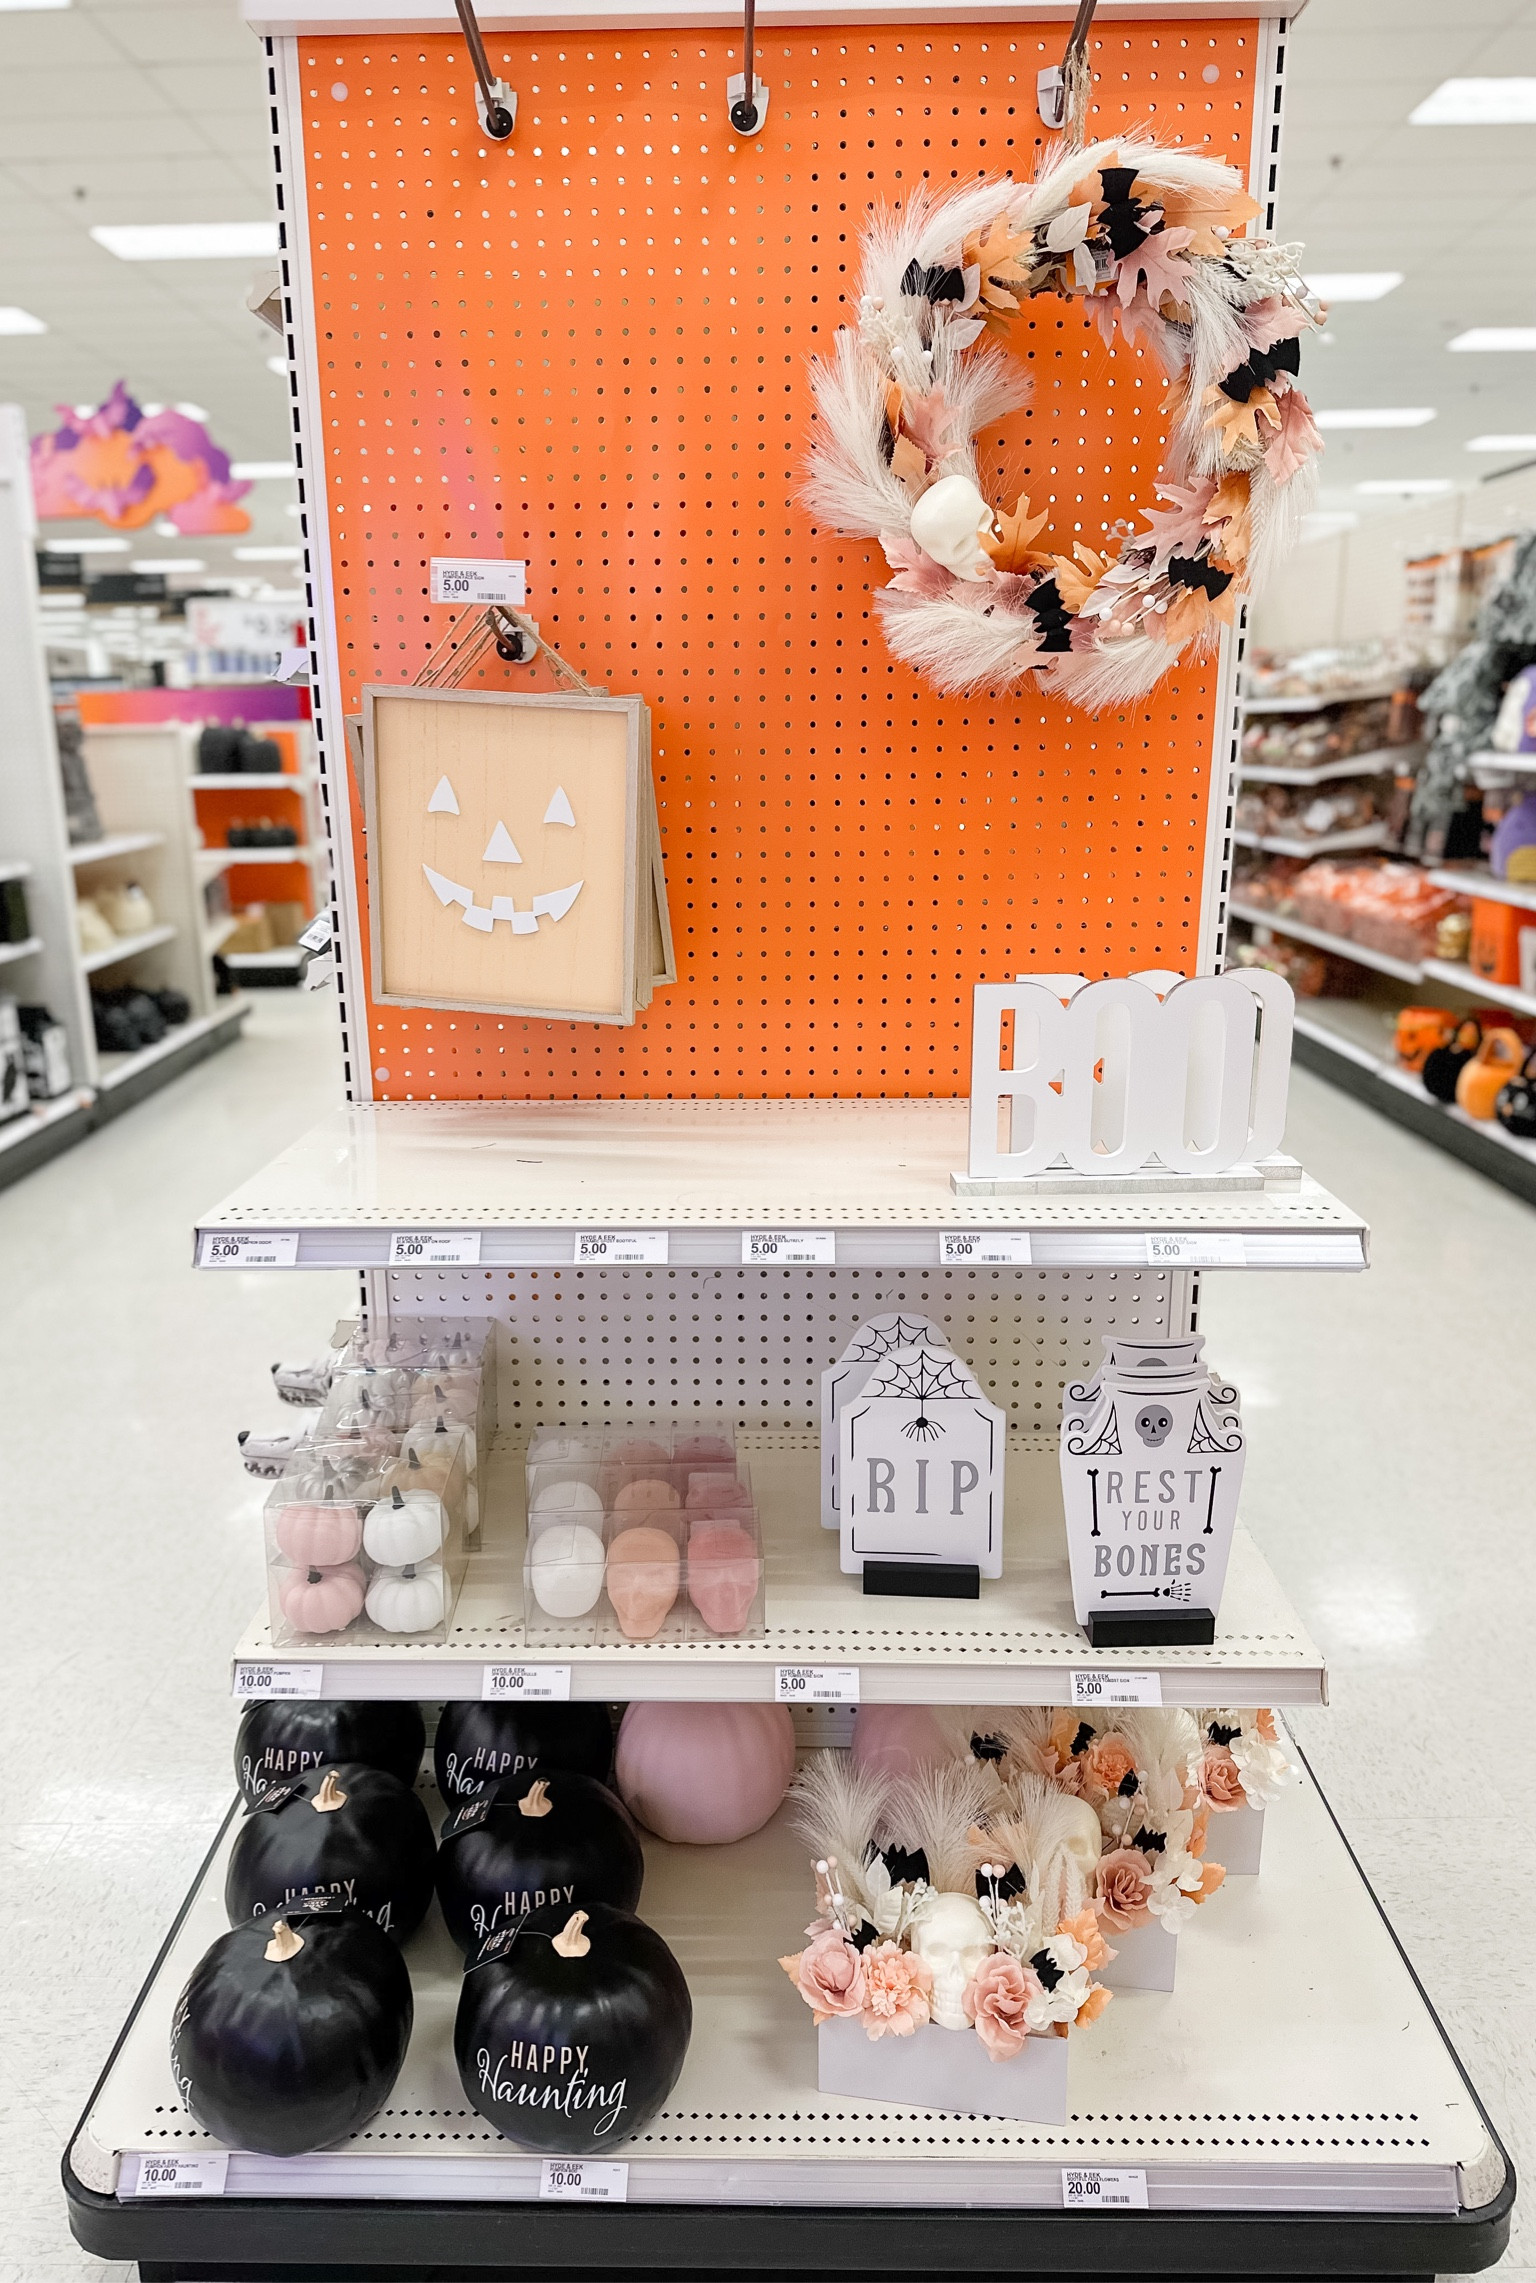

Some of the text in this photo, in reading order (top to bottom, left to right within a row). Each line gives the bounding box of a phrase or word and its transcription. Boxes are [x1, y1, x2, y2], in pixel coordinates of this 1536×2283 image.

[444, 580, 469, 591] 5.00
[969, 976, 1253, 1178] BOO
[211, 1245, 239, 1255] 5.00
[396, 1244, 423, 1254] 5.00
[581, 1243, 606, 1254] 5.00
[751, 1243, 777, 1253] 5.00
[946, 1244, 972, 1254] 5.00
[1153, 1245, 1180, 1255] 5.00
[1107, 1470, 1202, 1504] REST
[1122, 1510, 1180, 1531] YOUR
[1094, 1543, 1206, 1577] BONES
[240, 1675, 271, 1686] 10.00
[492, 1677, 523, 1688] 10.00
[781, 1678, 805, 1689] 5.00
[1077, 1683, 1102, 1694] 5.00
[264, 1747, 324, 1772] HAPPY
[473, 1746, 538, 1775] HAPPY
[504, 1884, 575, 1915] HAPPY
[510, 2040, 589, 2075] HAPPY
[476, 2047, 628, 2136] Haunting
[145, 2169, 176, 2181] 10.00
[550, 2173, 581, 2185] 10.00
[1068, 2182, 1100, 2194] 20.00
